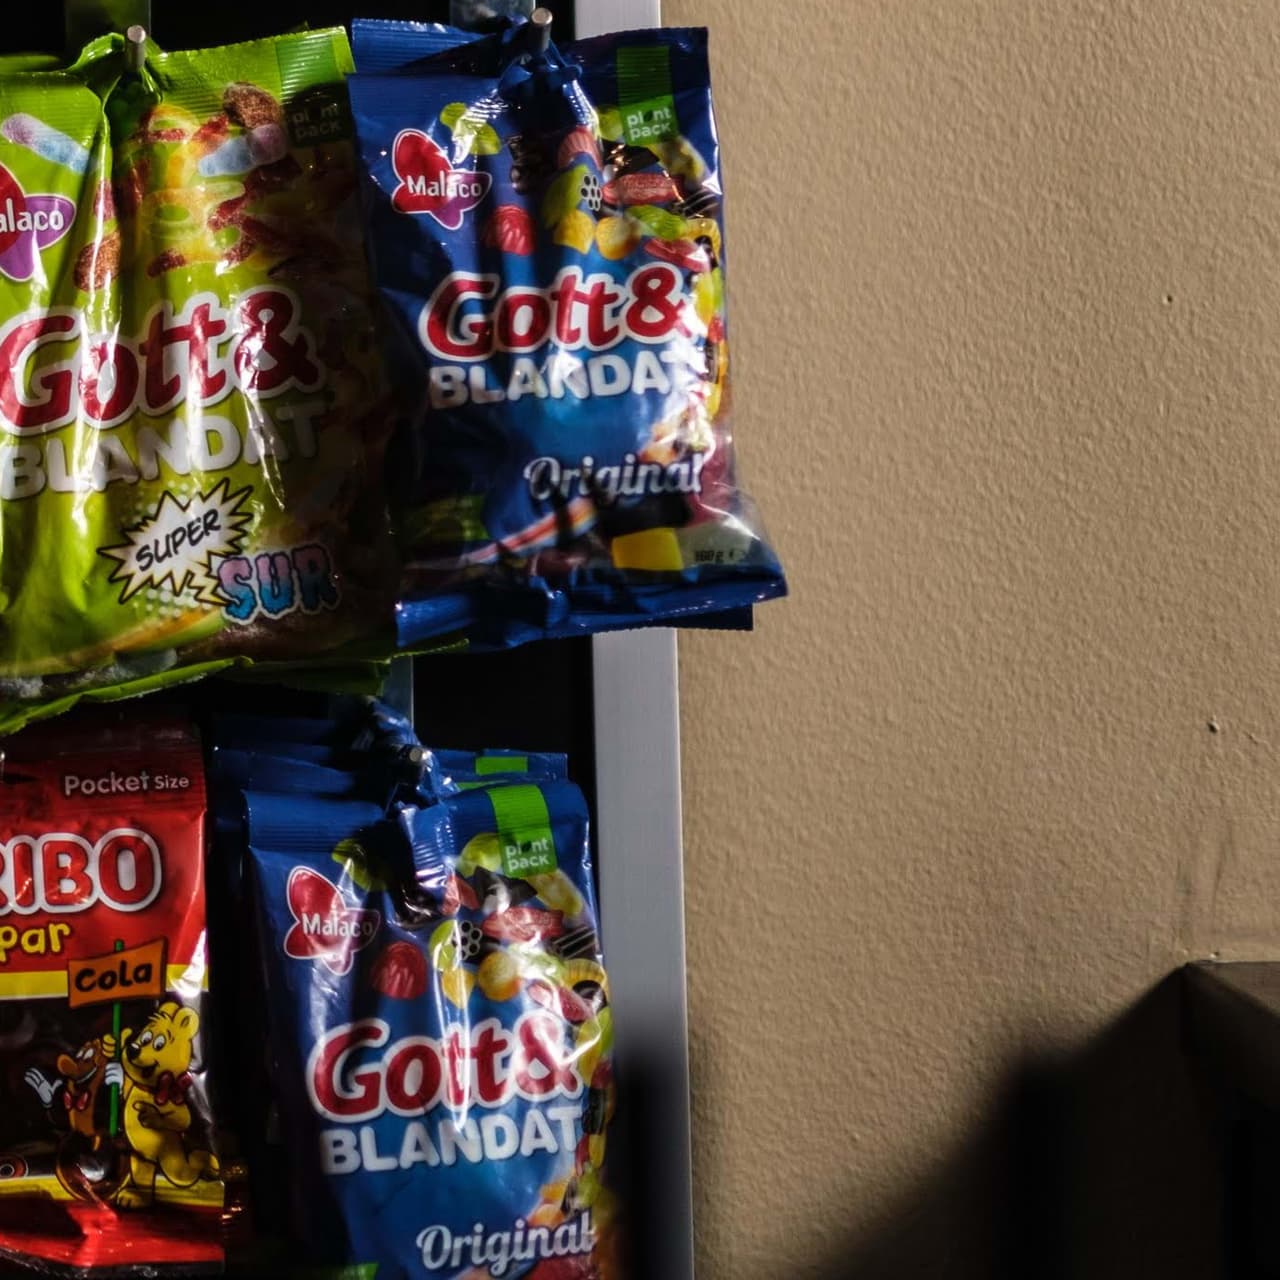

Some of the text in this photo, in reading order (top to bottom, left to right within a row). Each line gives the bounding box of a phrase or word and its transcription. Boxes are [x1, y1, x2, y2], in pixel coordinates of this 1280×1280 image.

[406, 173, 484, 198] Malaco
[0, 399, 327, 501] BLANDAT
[524, 454, 703, 501] Original
[136, 509, 223, 572] SUPER
[218, 546, 337, 622] SUR
[64, 772, 192, 798] Pocket Size
[301, 911, 374, 938] Malaco
[75, 959, 155, 996] Cola
[319, 1103, 583, 1176] BLANDAT
[416, 1210, 597, 1275] Original
